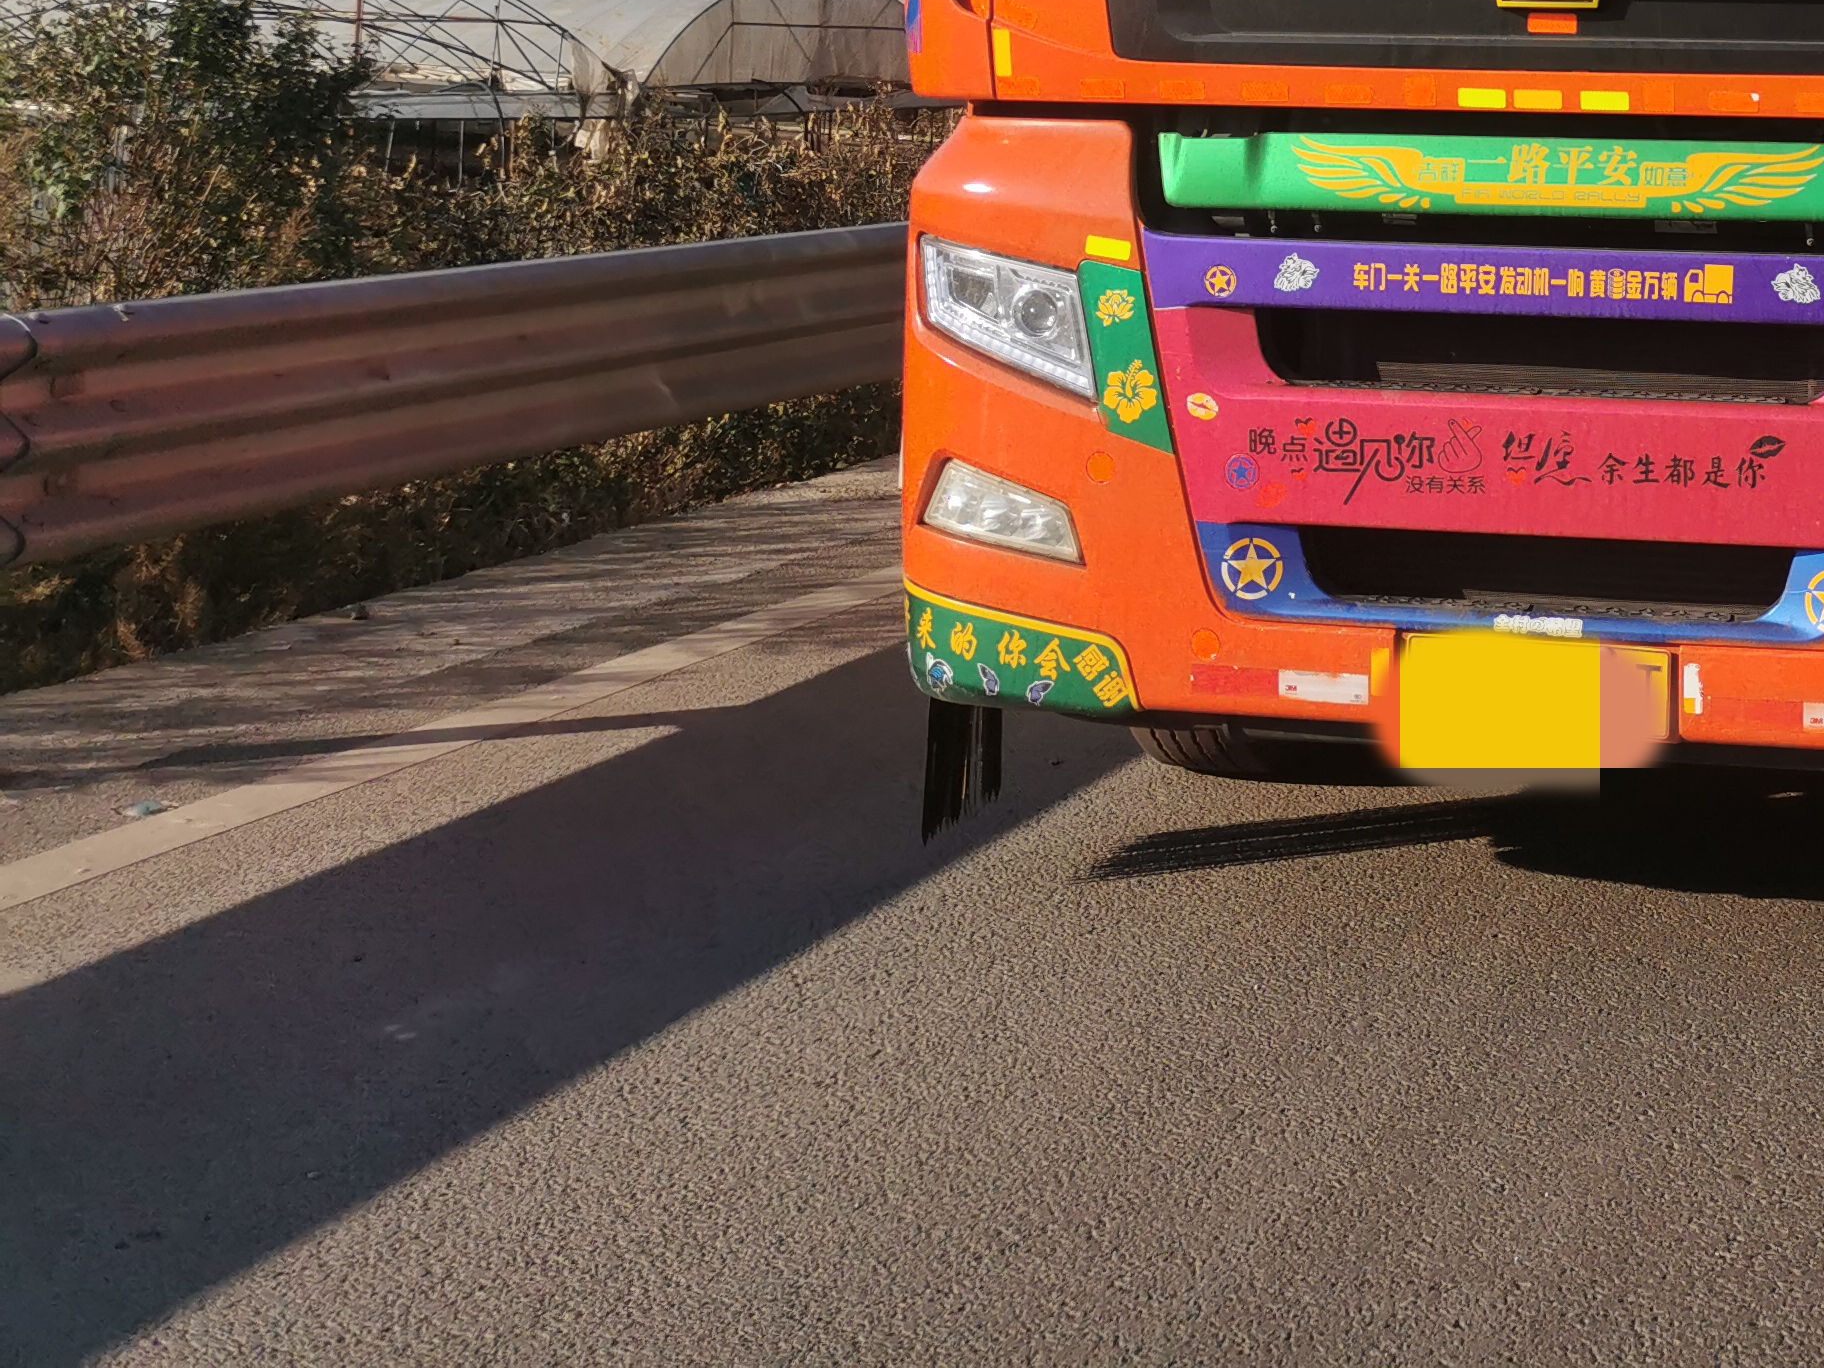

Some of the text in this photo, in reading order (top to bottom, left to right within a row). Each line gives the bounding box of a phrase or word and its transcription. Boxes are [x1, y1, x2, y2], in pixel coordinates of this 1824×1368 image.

[1467, 142, 1638, 187] 一路平安
[1499, 189, 1565, 201] WORLD
[1573, 190, 1642, 203] RALLY
[1405, 475, 1486, 495] 没有关系
